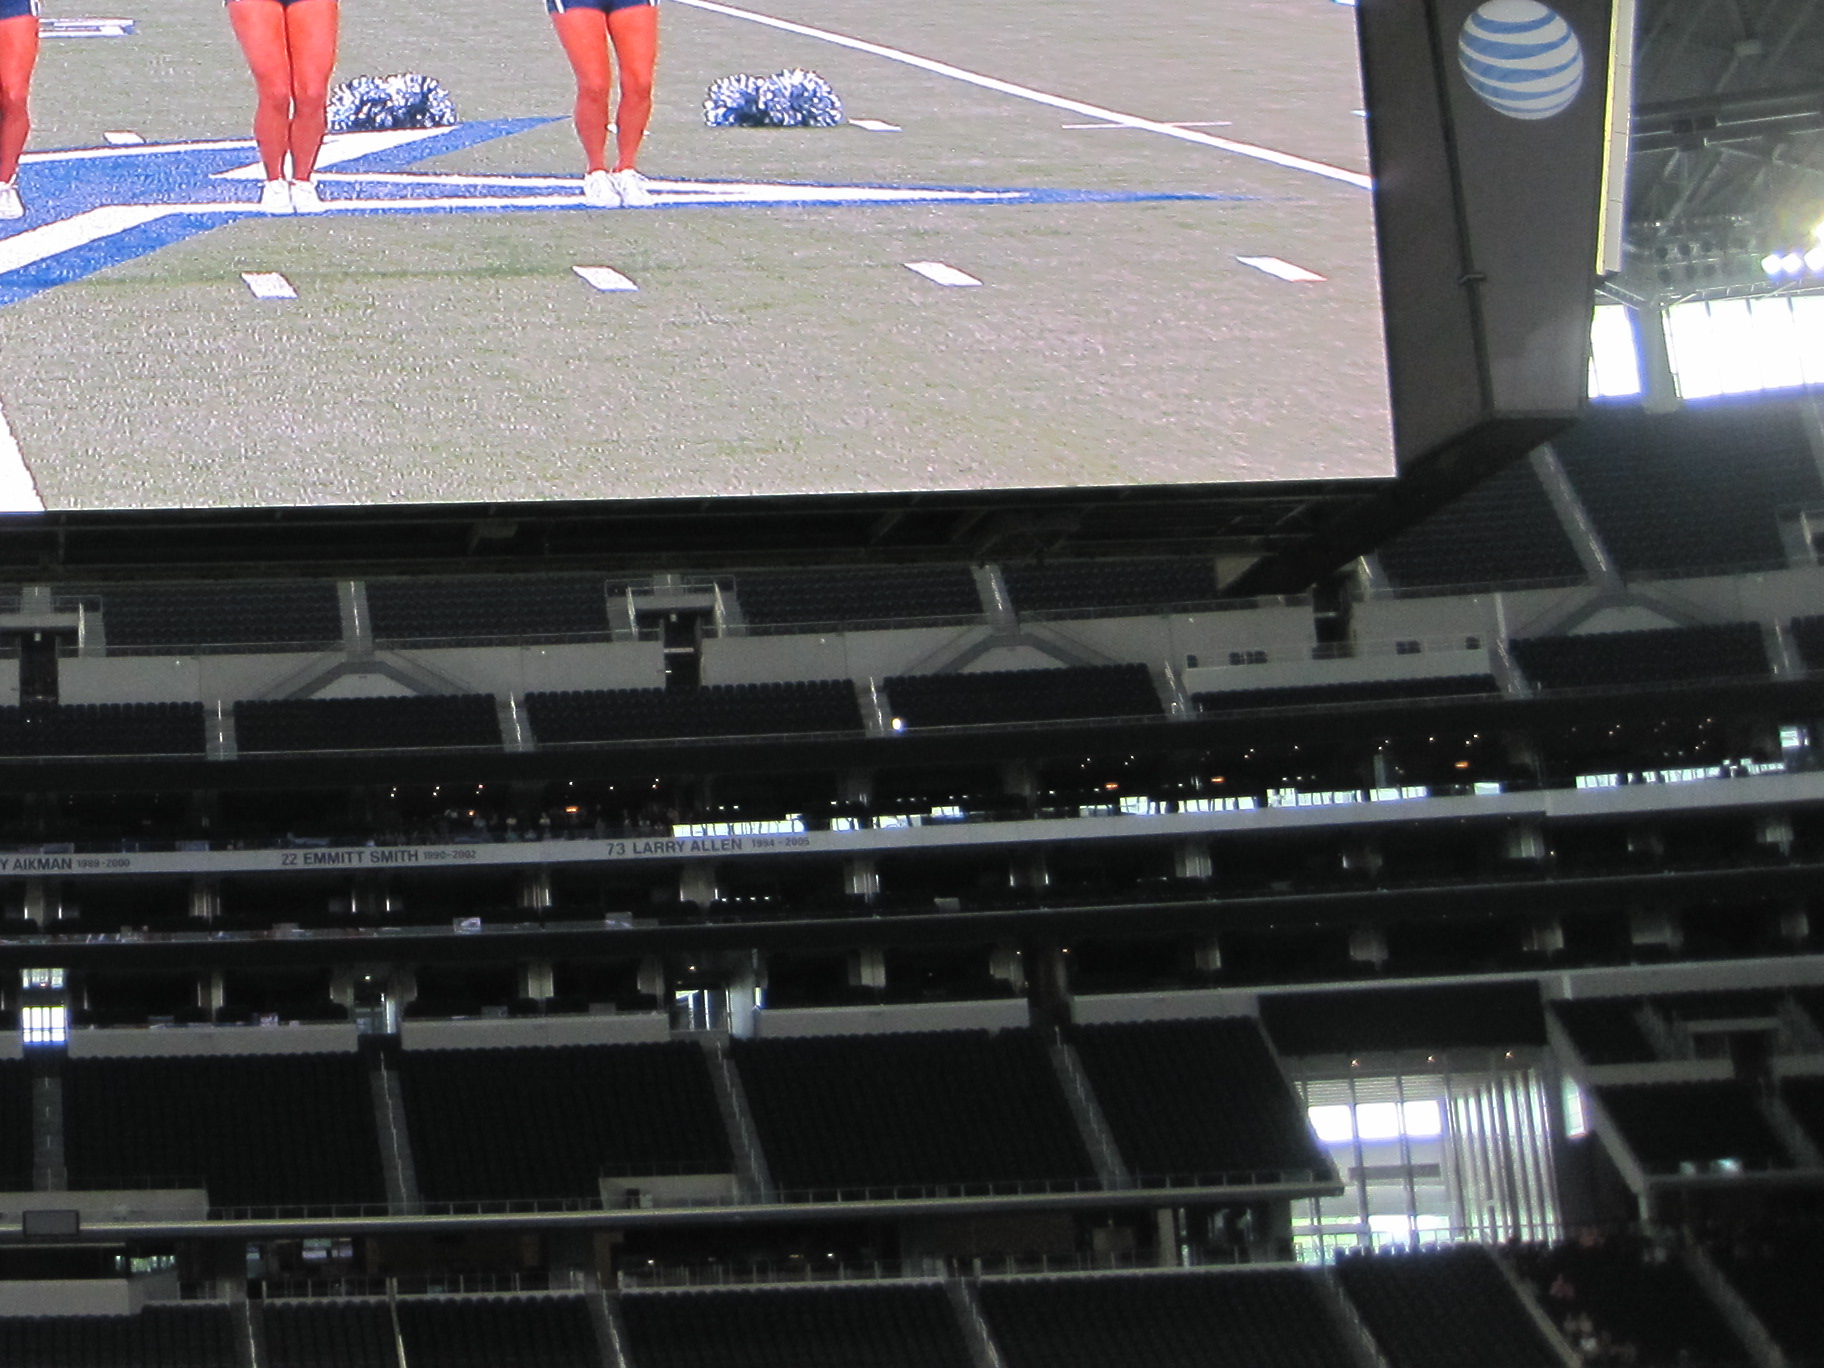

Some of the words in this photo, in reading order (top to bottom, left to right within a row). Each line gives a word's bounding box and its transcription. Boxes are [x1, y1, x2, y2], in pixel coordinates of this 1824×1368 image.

[607, 843, 626, 856] 73
[632, 840, 685, 854] LARRY
[690, 838, 743, 852] ALLEN
[12, 858, 72, 871] AIKMAN
[281, 853, 298, 866] 22
[303, 851, 364, 865] EMMITT
[370, 850, 419, 864] SMITH
